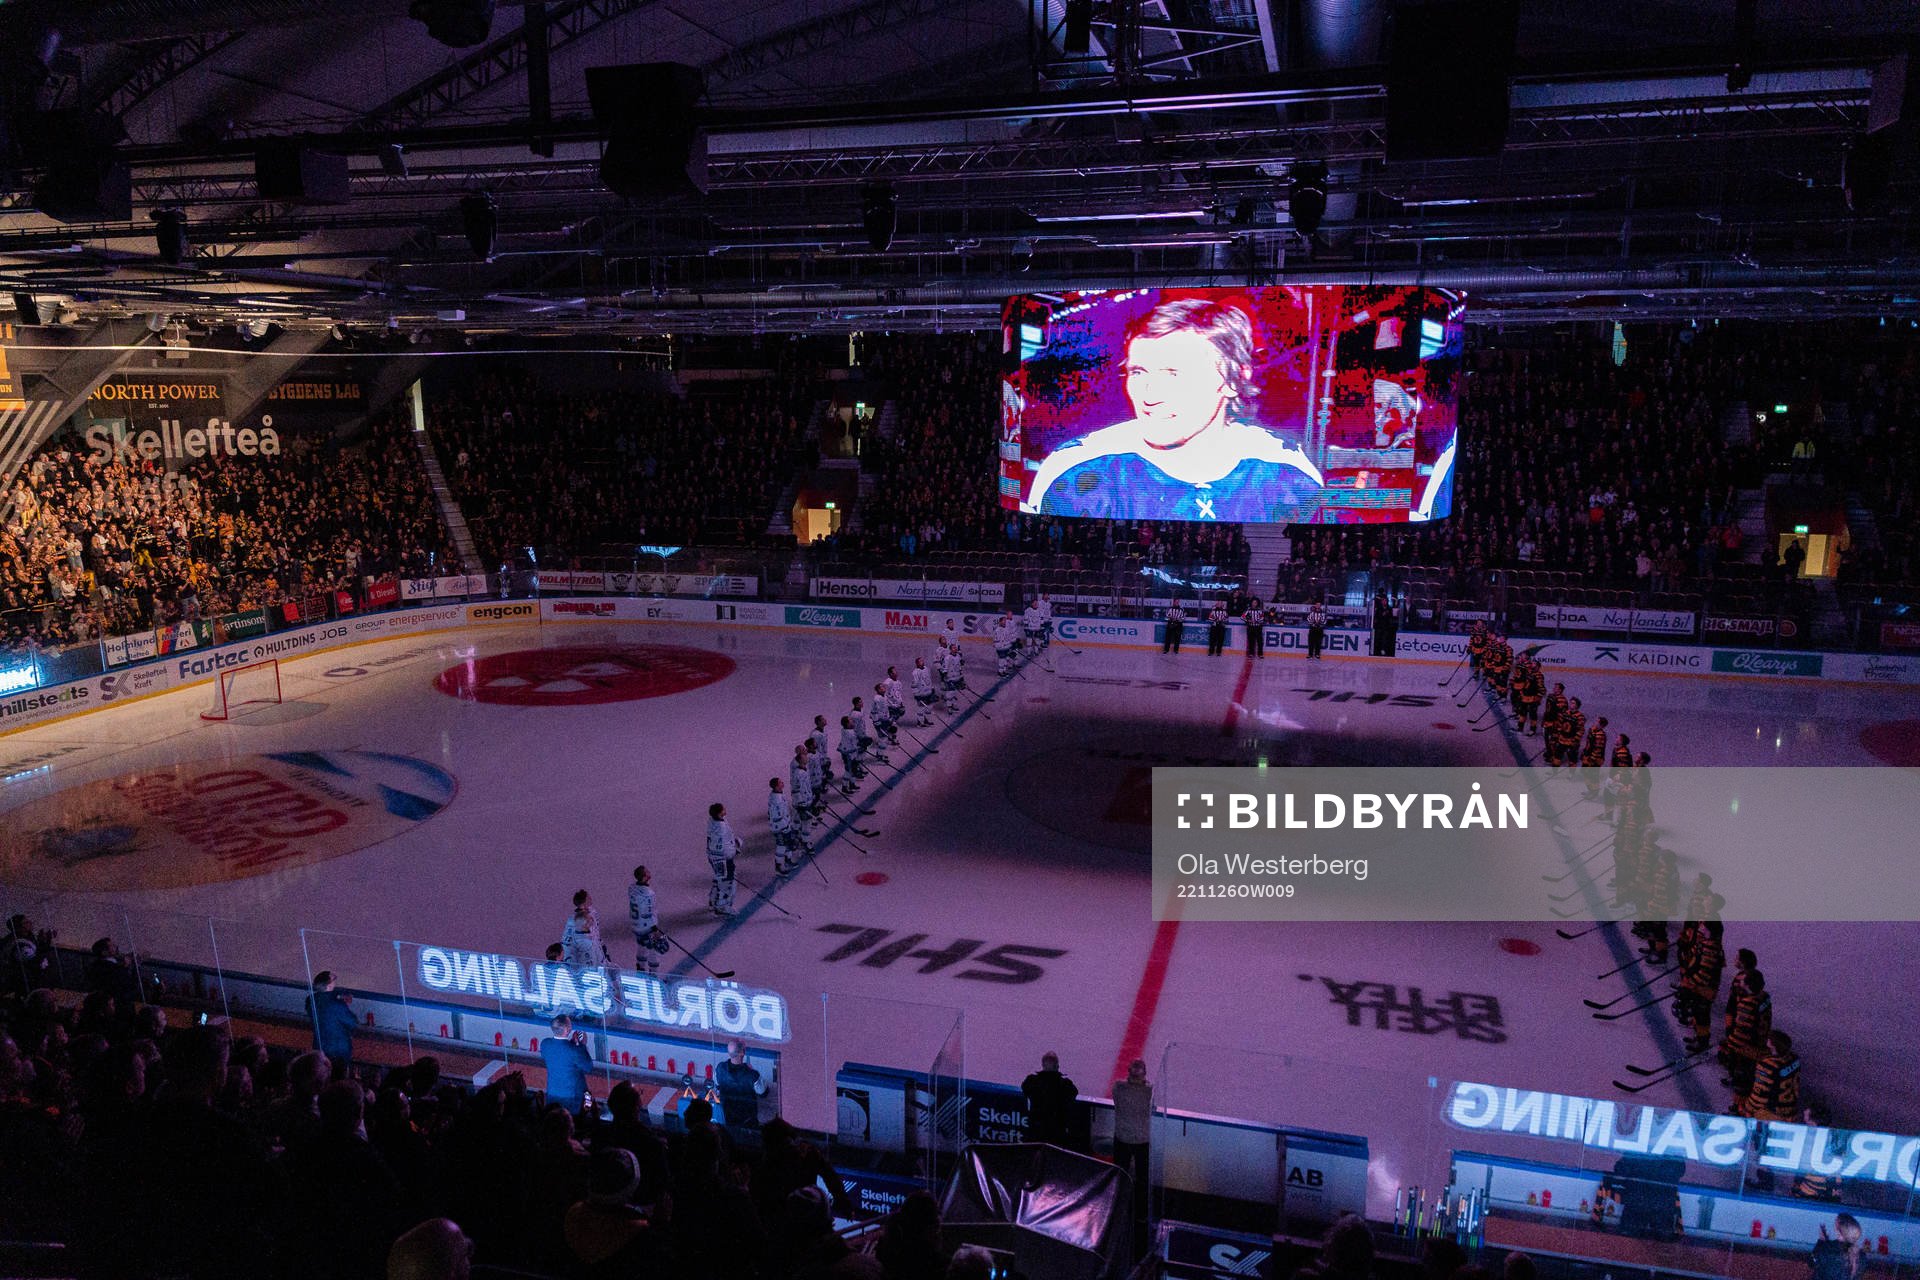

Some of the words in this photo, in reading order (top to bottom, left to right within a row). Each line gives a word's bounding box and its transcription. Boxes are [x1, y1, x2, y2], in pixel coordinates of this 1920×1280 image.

[88, 384, 156, 400] NORTH
[158, 384, 220, 400] POWER
[335, 383, 361, 399] LAG
[85, 414, 281, 465] Skellefteå
[819, 581, 878, 596] Henson
[897, 582, 950, 596] Norrands
[950, 585, 963, 597] Bil
[389, 609, 457, 626] energiservice
[473, 604, 532, 620] engcon
[647, 607, 661, 618] EY
[885, 611, 928, 627] MAXI
[1602, 611, 1669, 628] Norlands
[1671, 615, 1691, 629] Bil
[222, 615, 266, 632] artinsons
[355, 619, 386, 630] GROUP
[1078, 624, 1138, 636] extena
[319, 626, 348, 641] JOB
[1265, 631, 1359, 651] BOLDEN
[265, 633, 316, 656] HULTDINS
[179, 649, 249, 679] Fastec
[1628, 652, 1700, 667] KAIDING
[978, 1106, 1030, 1128] Skelle
[978, 1124, 1024, 1144] Kraft
[1287, 1166, 1324, 1186] AB
[860, 1188, 907, 1205] Skelleft
